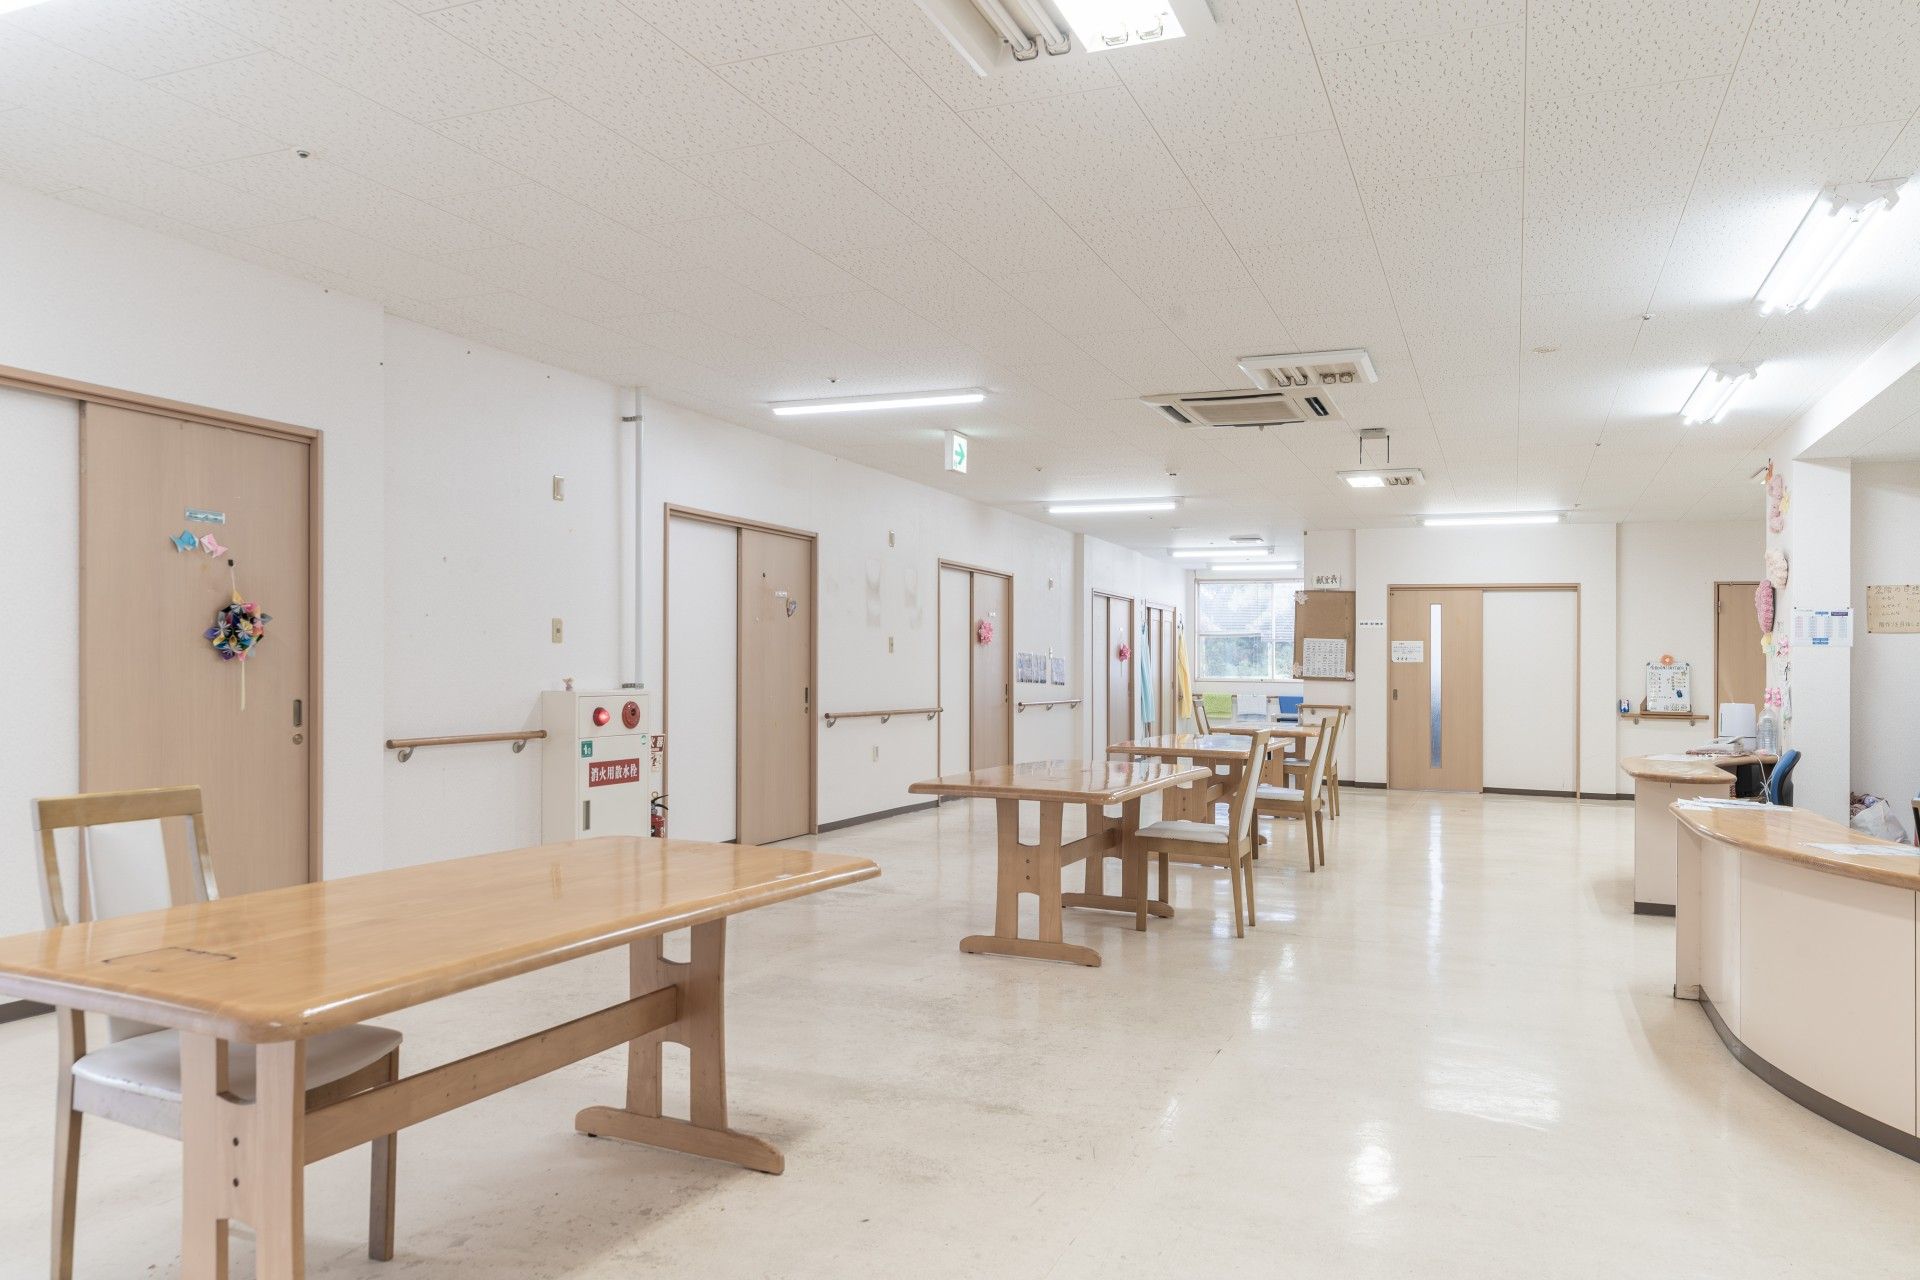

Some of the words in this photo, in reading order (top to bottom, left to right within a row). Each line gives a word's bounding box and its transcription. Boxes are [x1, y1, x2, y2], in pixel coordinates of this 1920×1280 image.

[591, 763, 638, 782] 消火用散水栓
